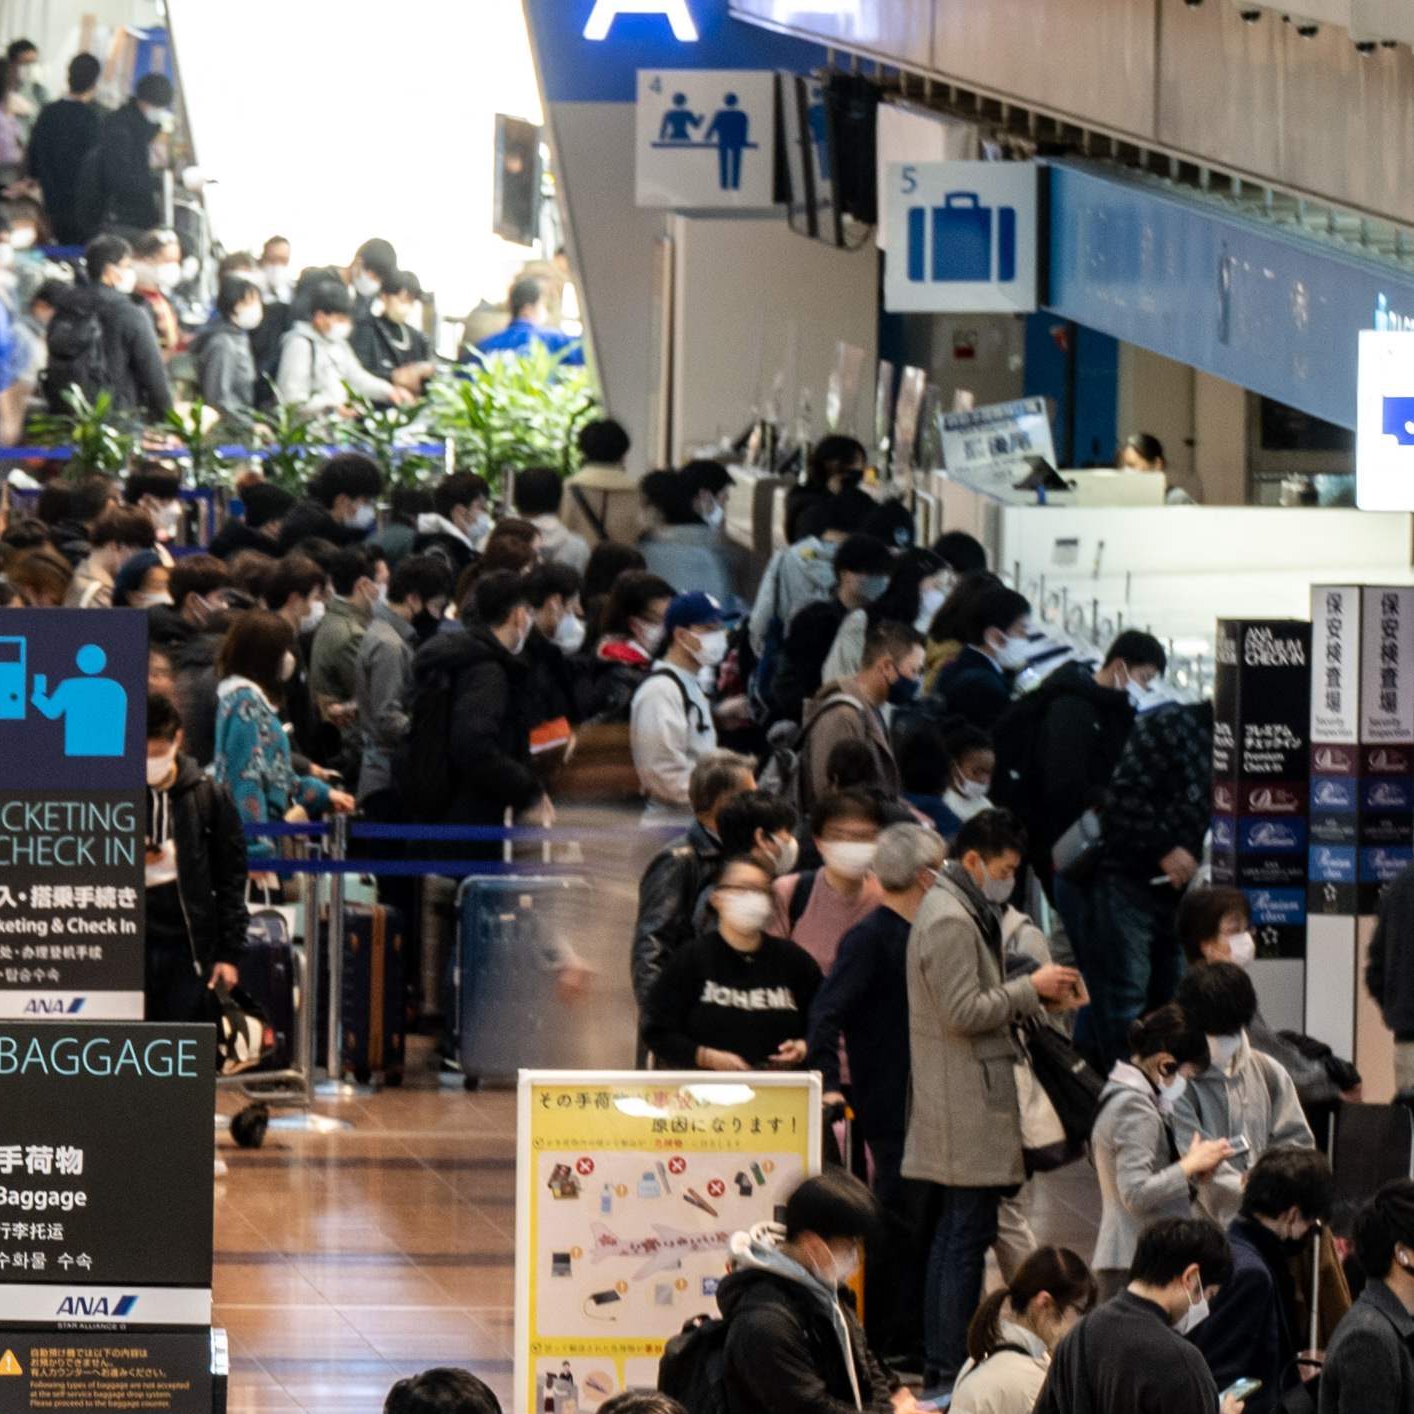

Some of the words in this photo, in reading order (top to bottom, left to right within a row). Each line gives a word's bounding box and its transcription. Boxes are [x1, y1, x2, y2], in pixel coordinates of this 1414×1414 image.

[648, 75, 662, 93] 4
[901, 168, 918, 194] 5
[105, 837, 136, 866] IN
[51, 917, 64, 934] &
[66, 917, 117, 934] Check
[121, 918, 136, 934] In
[24, 999, 64, 1013] ANA
[57, 1252, 93, 1271] 수속
[56, 1296, 109, 1316] ANA
